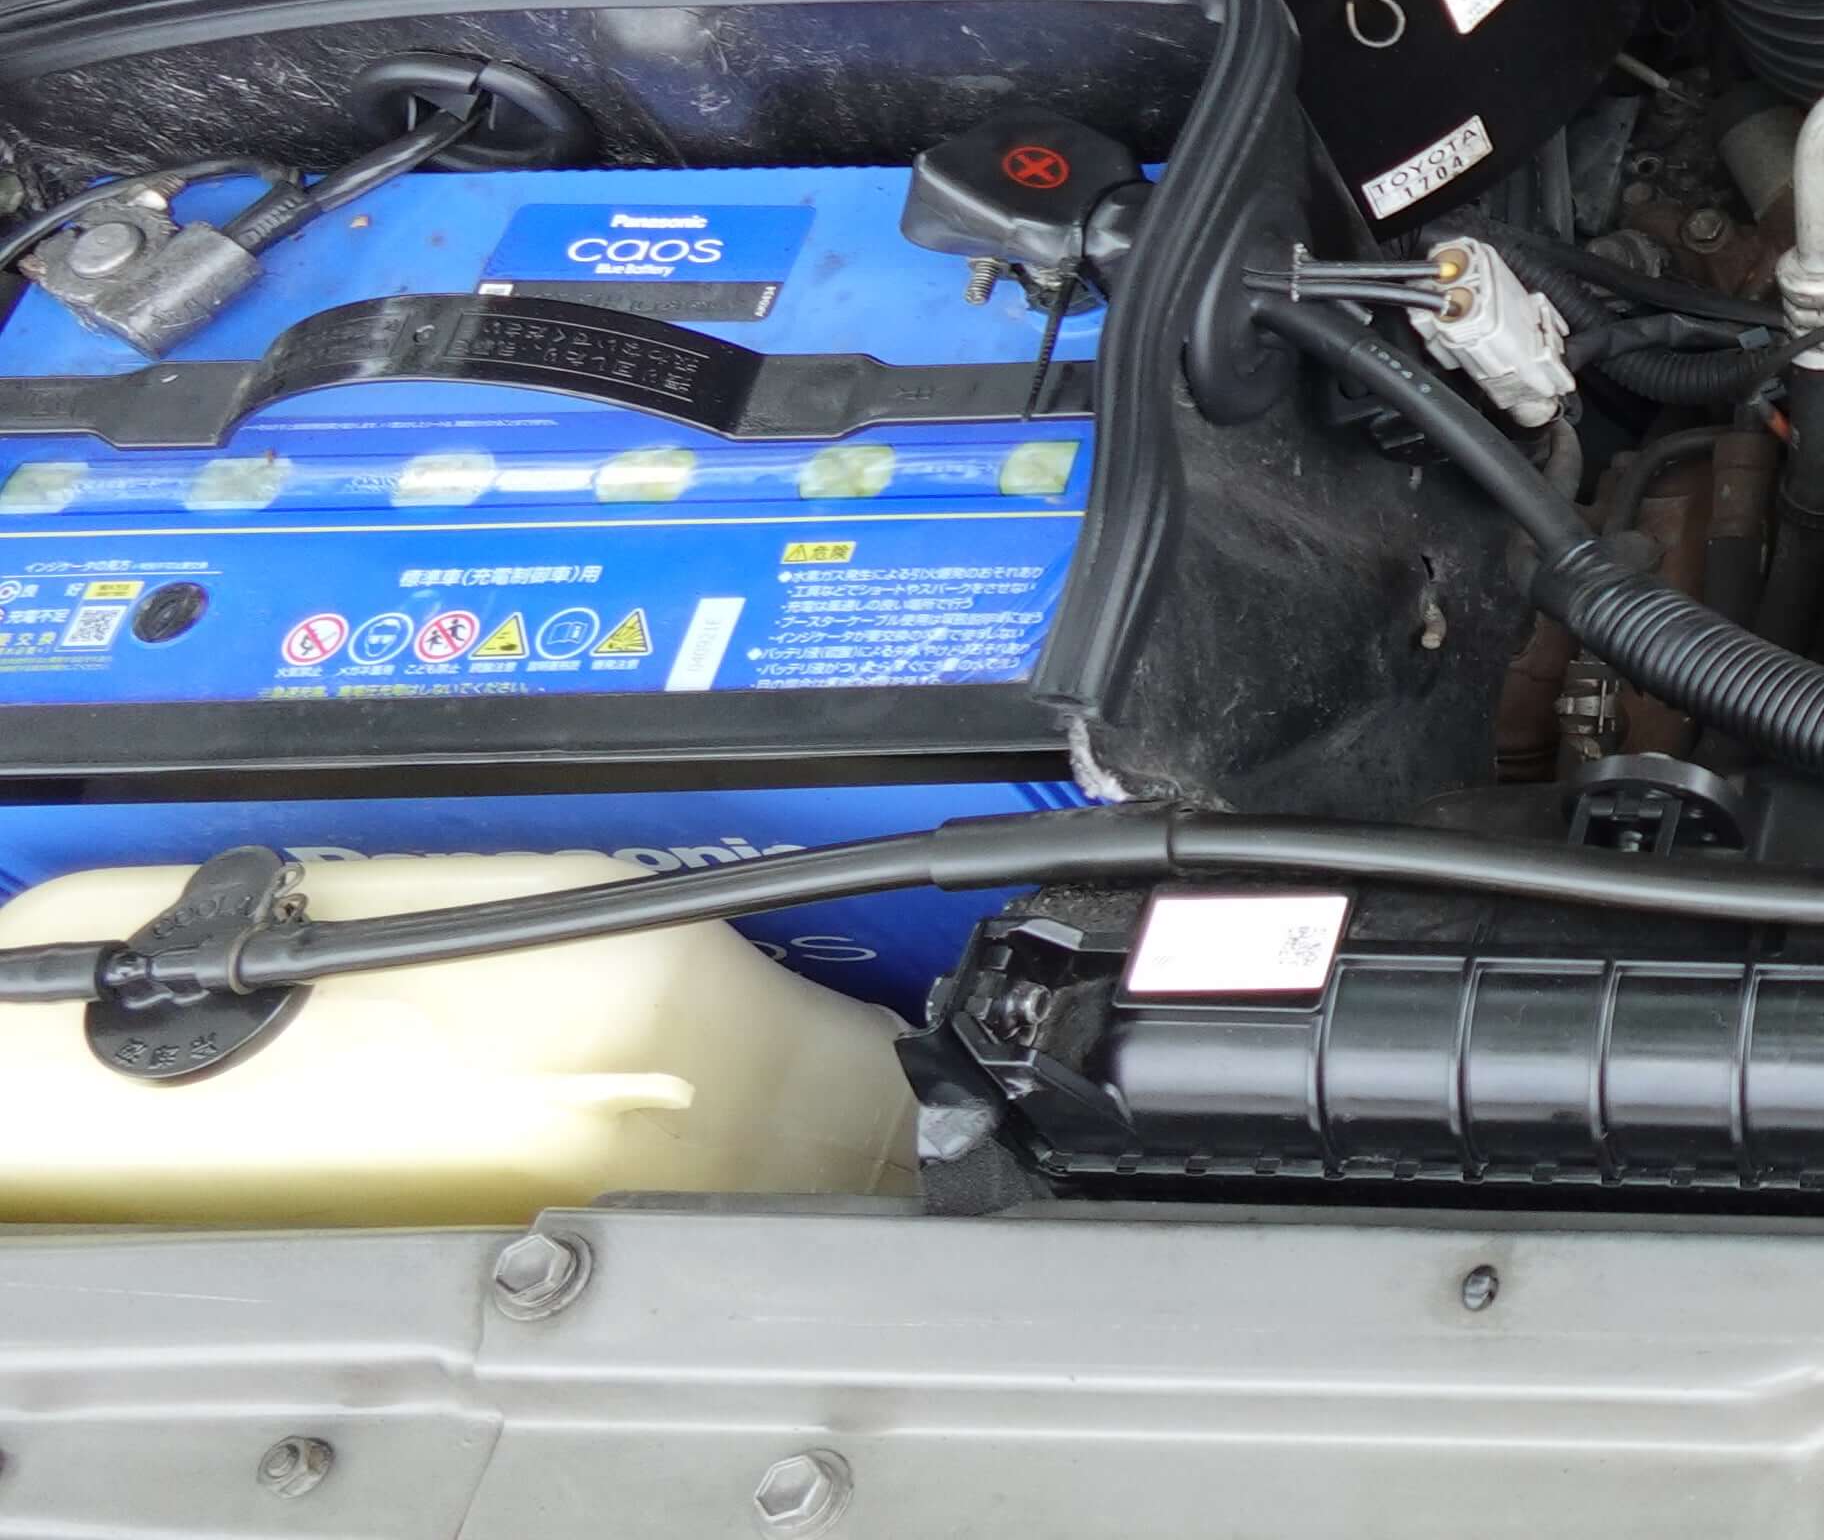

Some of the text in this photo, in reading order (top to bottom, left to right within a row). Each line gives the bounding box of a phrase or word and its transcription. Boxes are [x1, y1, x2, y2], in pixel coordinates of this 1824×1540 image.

[1375, 129, 1476, 195] TOYOTA
[1405, 156, 1463, 198] 1704
[610, 214, 708, 228] Panasonic
[566, 237, 723, 264] caos
[812, 543, 850, 561] 危険
